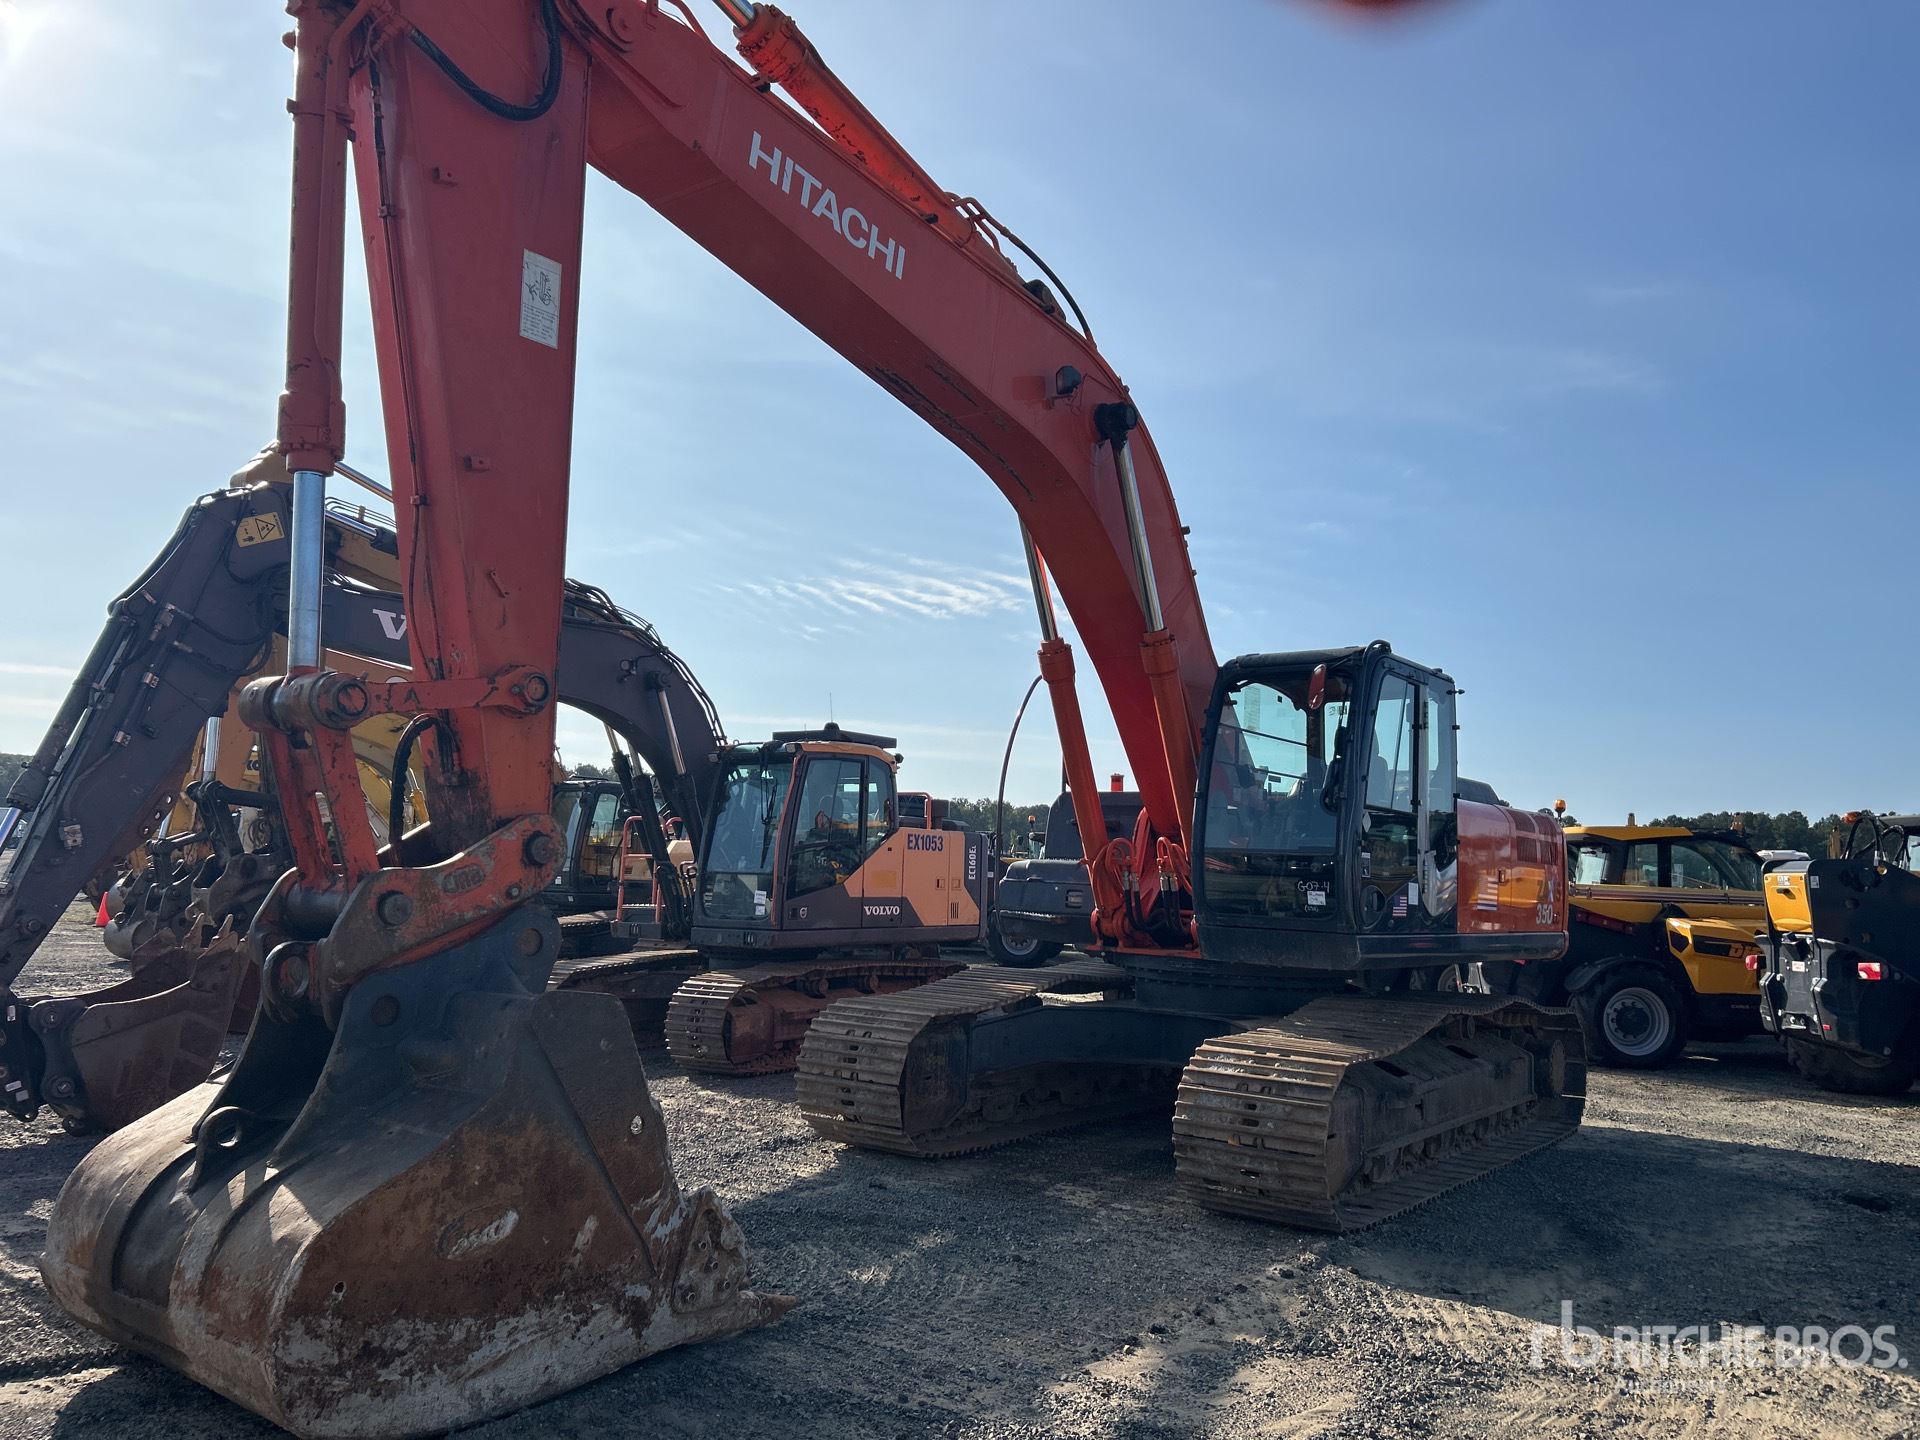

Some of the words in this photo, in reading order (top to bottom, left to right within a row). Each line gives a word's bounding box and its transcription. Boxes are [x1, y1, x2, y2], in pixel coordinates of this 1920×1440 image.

[749, 130, 906, 280] HITACHI
[907, 833, 944, 851] EX1053
[864, 905, 900, 916] VOLVO
